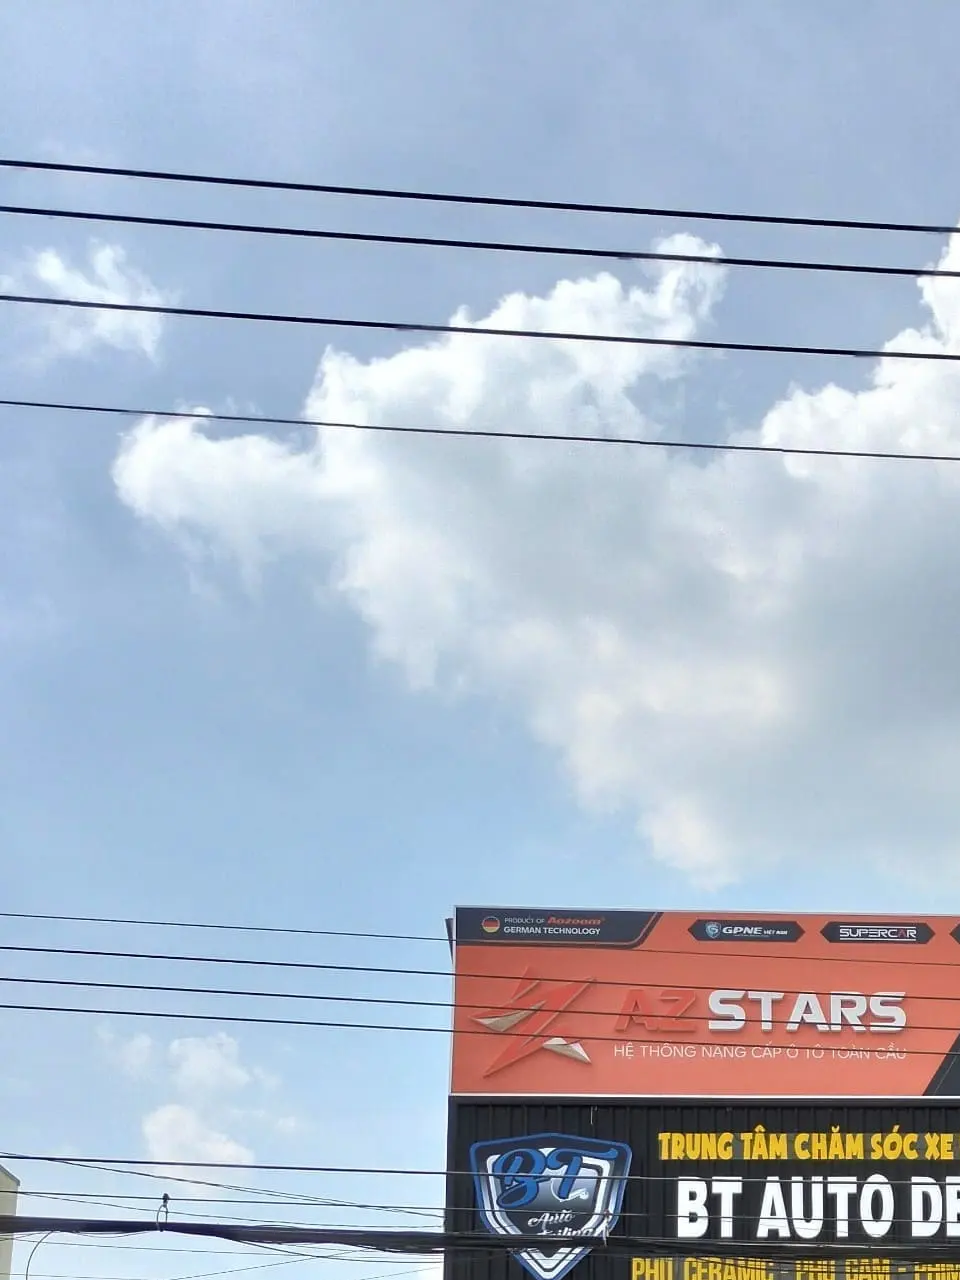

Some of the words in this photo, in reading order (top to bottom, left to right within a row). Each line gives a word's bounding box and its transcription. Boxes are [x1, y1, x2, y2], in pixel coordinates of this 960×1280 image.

[503, 926, 541, 934] GERMAN
[543, 926, 601, 936] TECHNOLOGY
[722, 926, 762, 935] GPNE
[839, 927, 917, 939] SUPERCAR
[614, 988, 698, 1033] AZ
[707, 988, 908, 1034] STARS
[613, 1041, 634, 1061] HỆ
[785, 1043, 799, 1059] Ô
[804, 1043, 825, 1059] TÔ
[658, 1131, 734, 1161] TRUNG
[741, 1124, 788, 1161] TÂM
[794, 1126, 864, 1161] CHĂM
[870, 1125, 918, 1160] SÓC
[924, 1131, 953, 1160] XE
[676, 1175, 743, 1239] BT
[756, 1174, 895, 1239] AUTO
